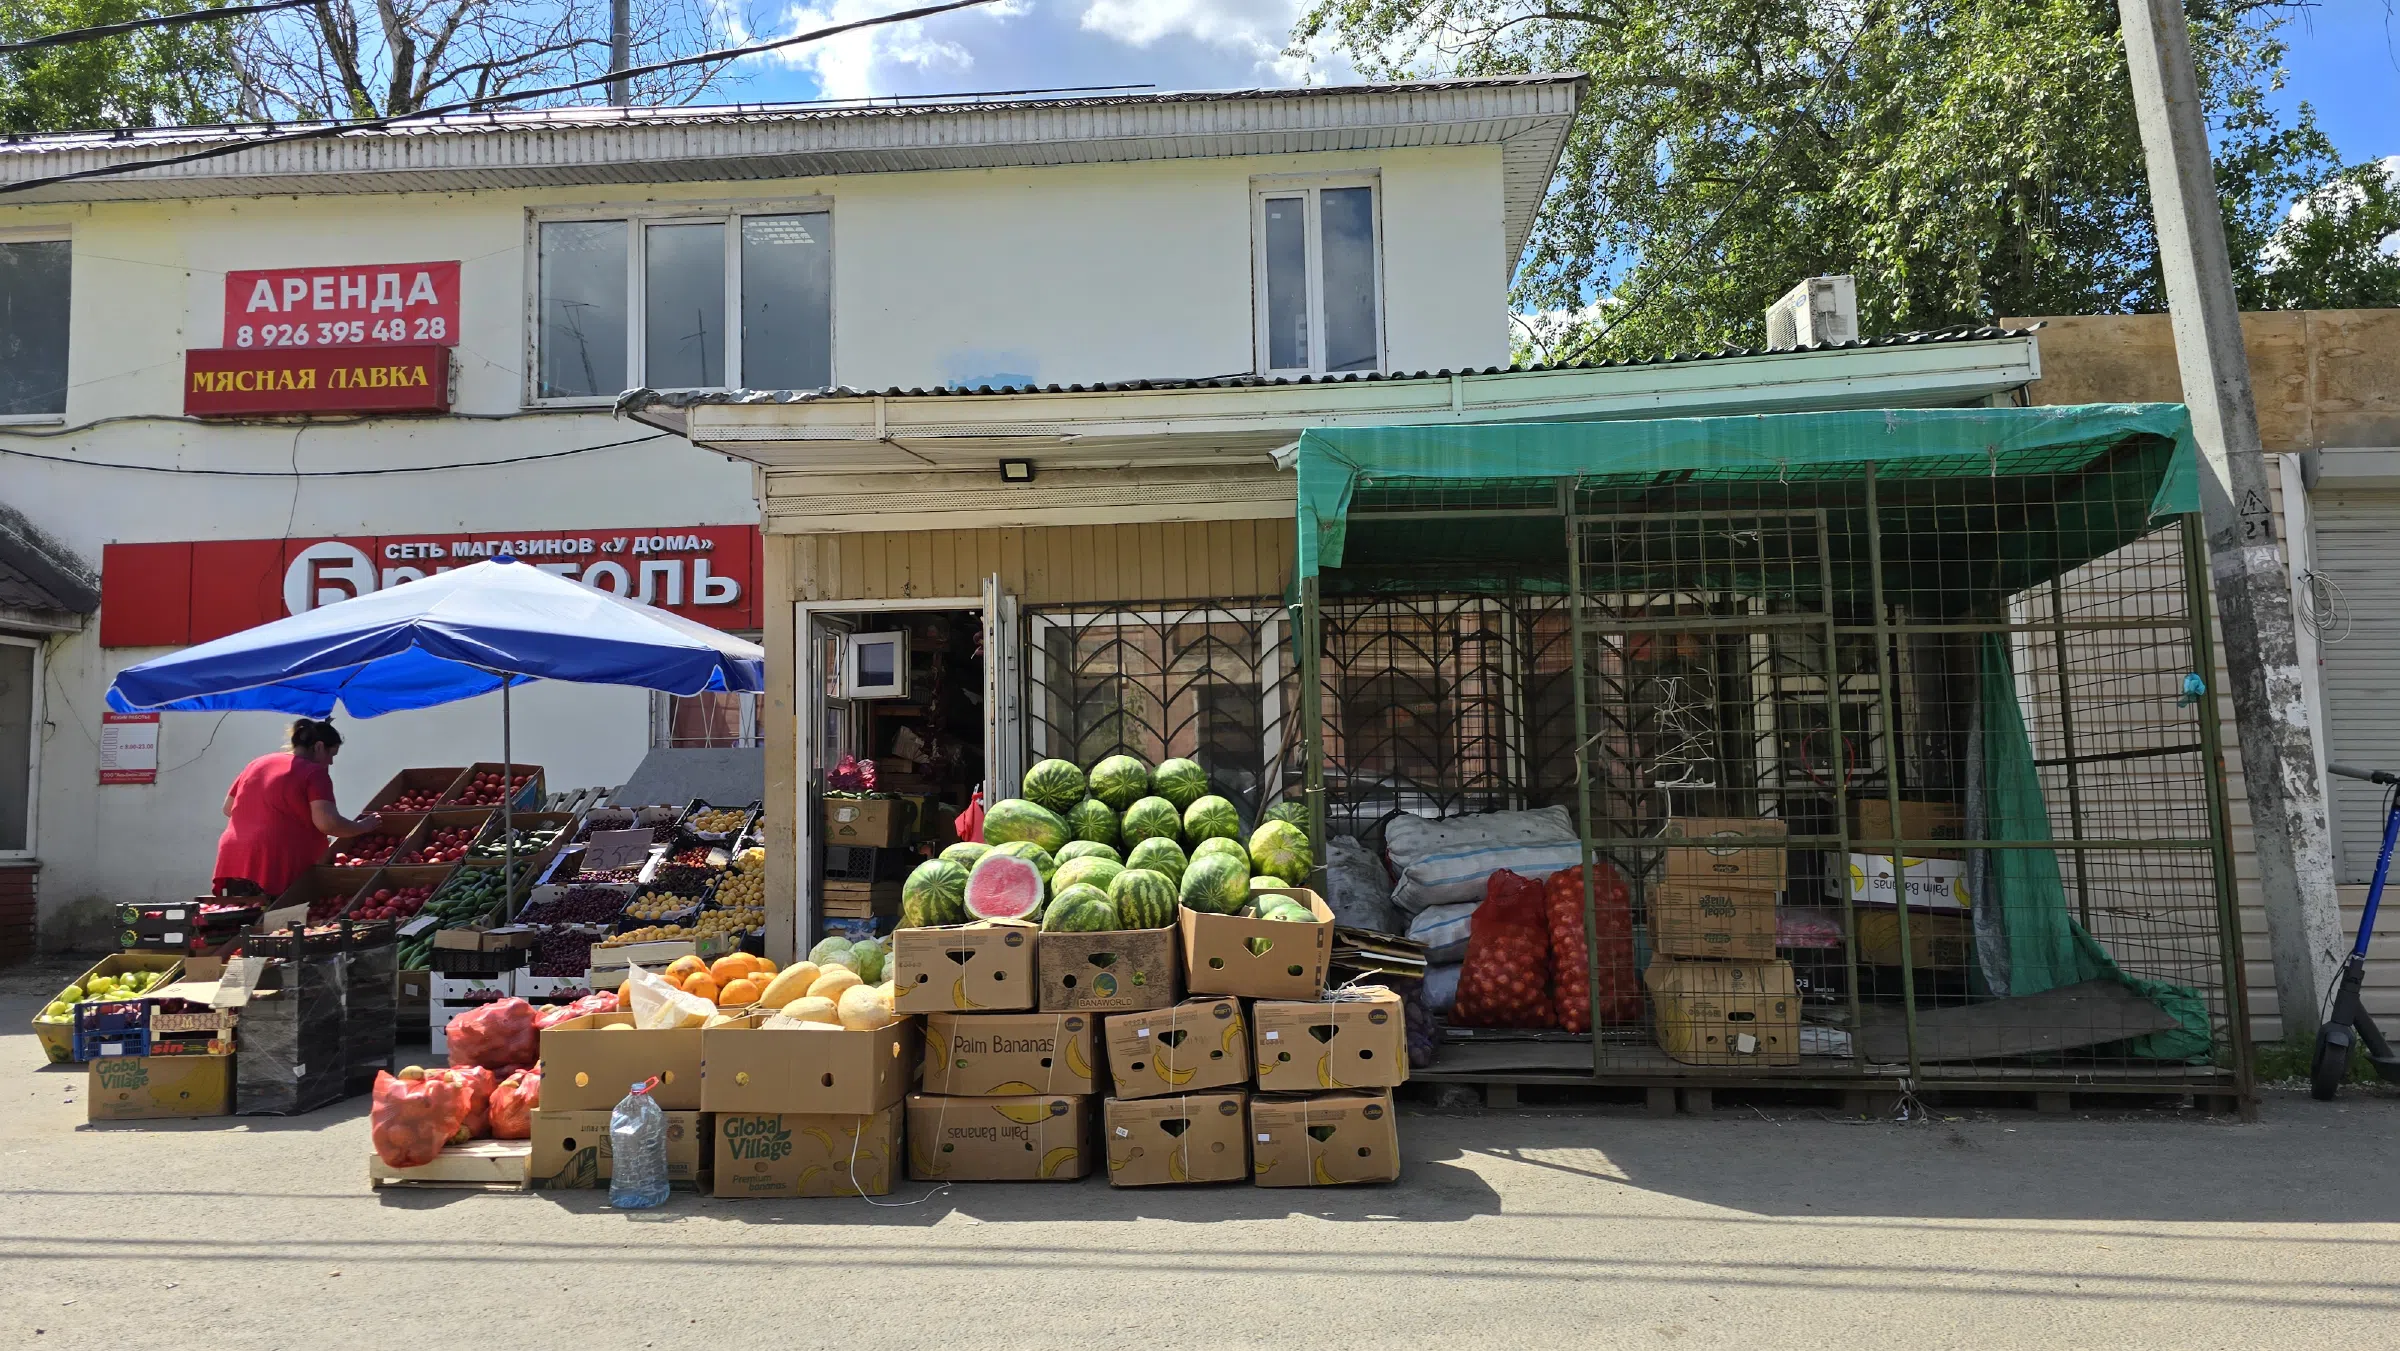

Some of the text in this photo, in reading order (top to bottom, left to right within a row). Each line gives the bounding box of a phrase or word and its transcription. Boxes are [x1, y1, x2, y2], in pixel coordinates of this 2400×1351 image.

[246, 272, 438, 313] АРЕНДА
[236, 317, 446, 348] 8 926 395 48 28
[192, 366, 428, 393] МЯСНАЯ ЛАВКА
[2245, 520, 2271, 539] 21
[385, 535, 714, 560] СЕТЬ МАГАЗИНОВ «У ДОМА»
[1874, 879, 1949, 897] Palm Banas
[1080, 998, 1133, 1007] BANAWORLD
[954, 1035, 1055, 1053] Palm Bananas
[96, 1058, 141, 1075] Global
[100, 1073, 149, 1090] Village
[723, 1114, 784, 1138] Global
[948, 1126, 1029, 1142] Palm Bananas
[727, 1137, 792, 1161] Village
[732, 1174, 772, 1184] Premium
[748, 1182, 787, 1192] bananas
